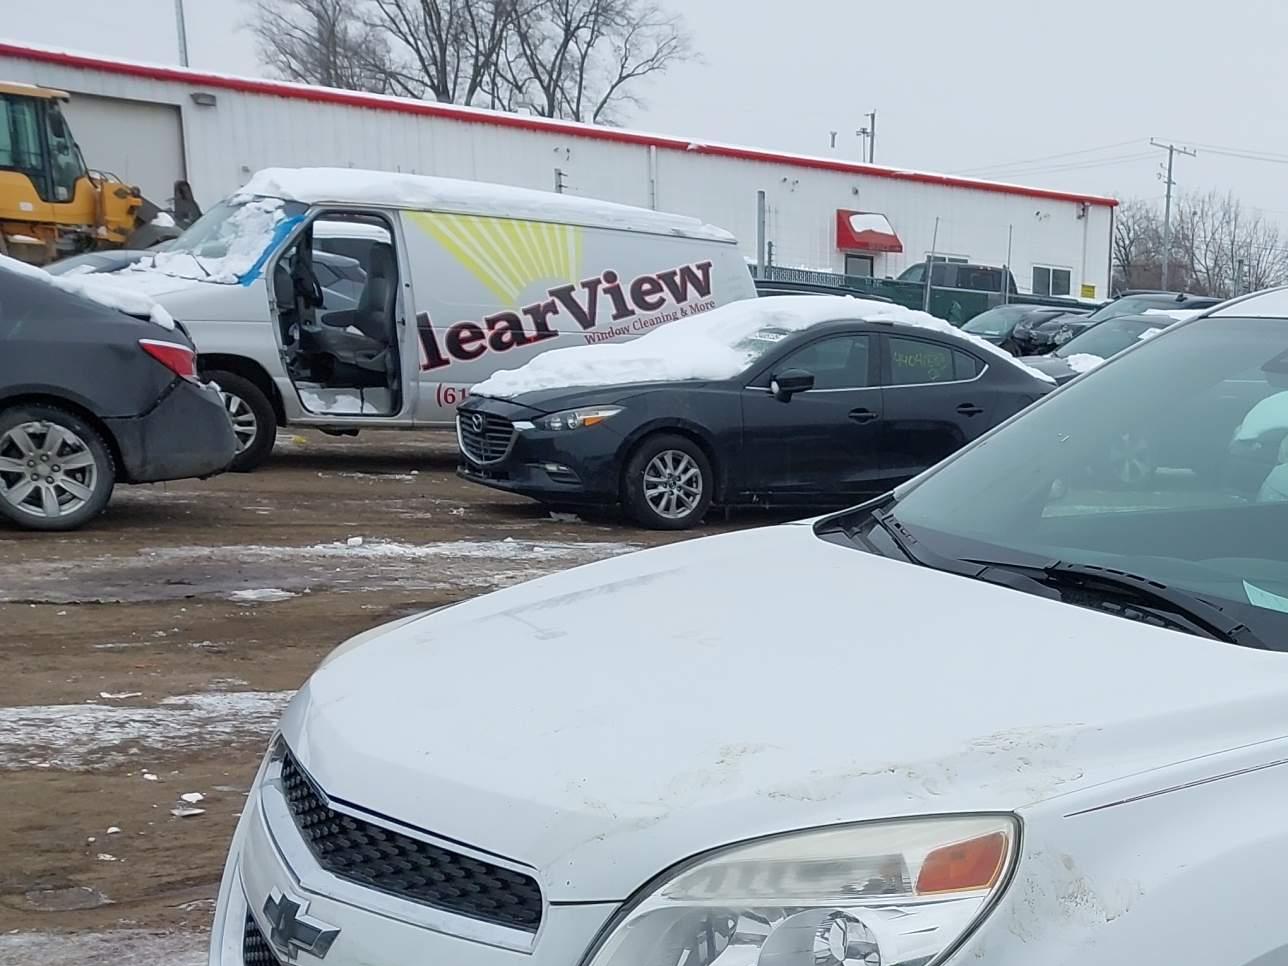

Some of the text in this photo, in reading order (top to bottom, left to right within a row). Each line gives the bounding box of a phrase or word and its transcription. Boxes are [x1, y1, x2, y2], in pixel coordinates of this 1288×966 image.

[417, 261, 713, 371] learView
[584, 300, 716, 345] Window Cleaning & More
[436, 383, 467, 407] (61
